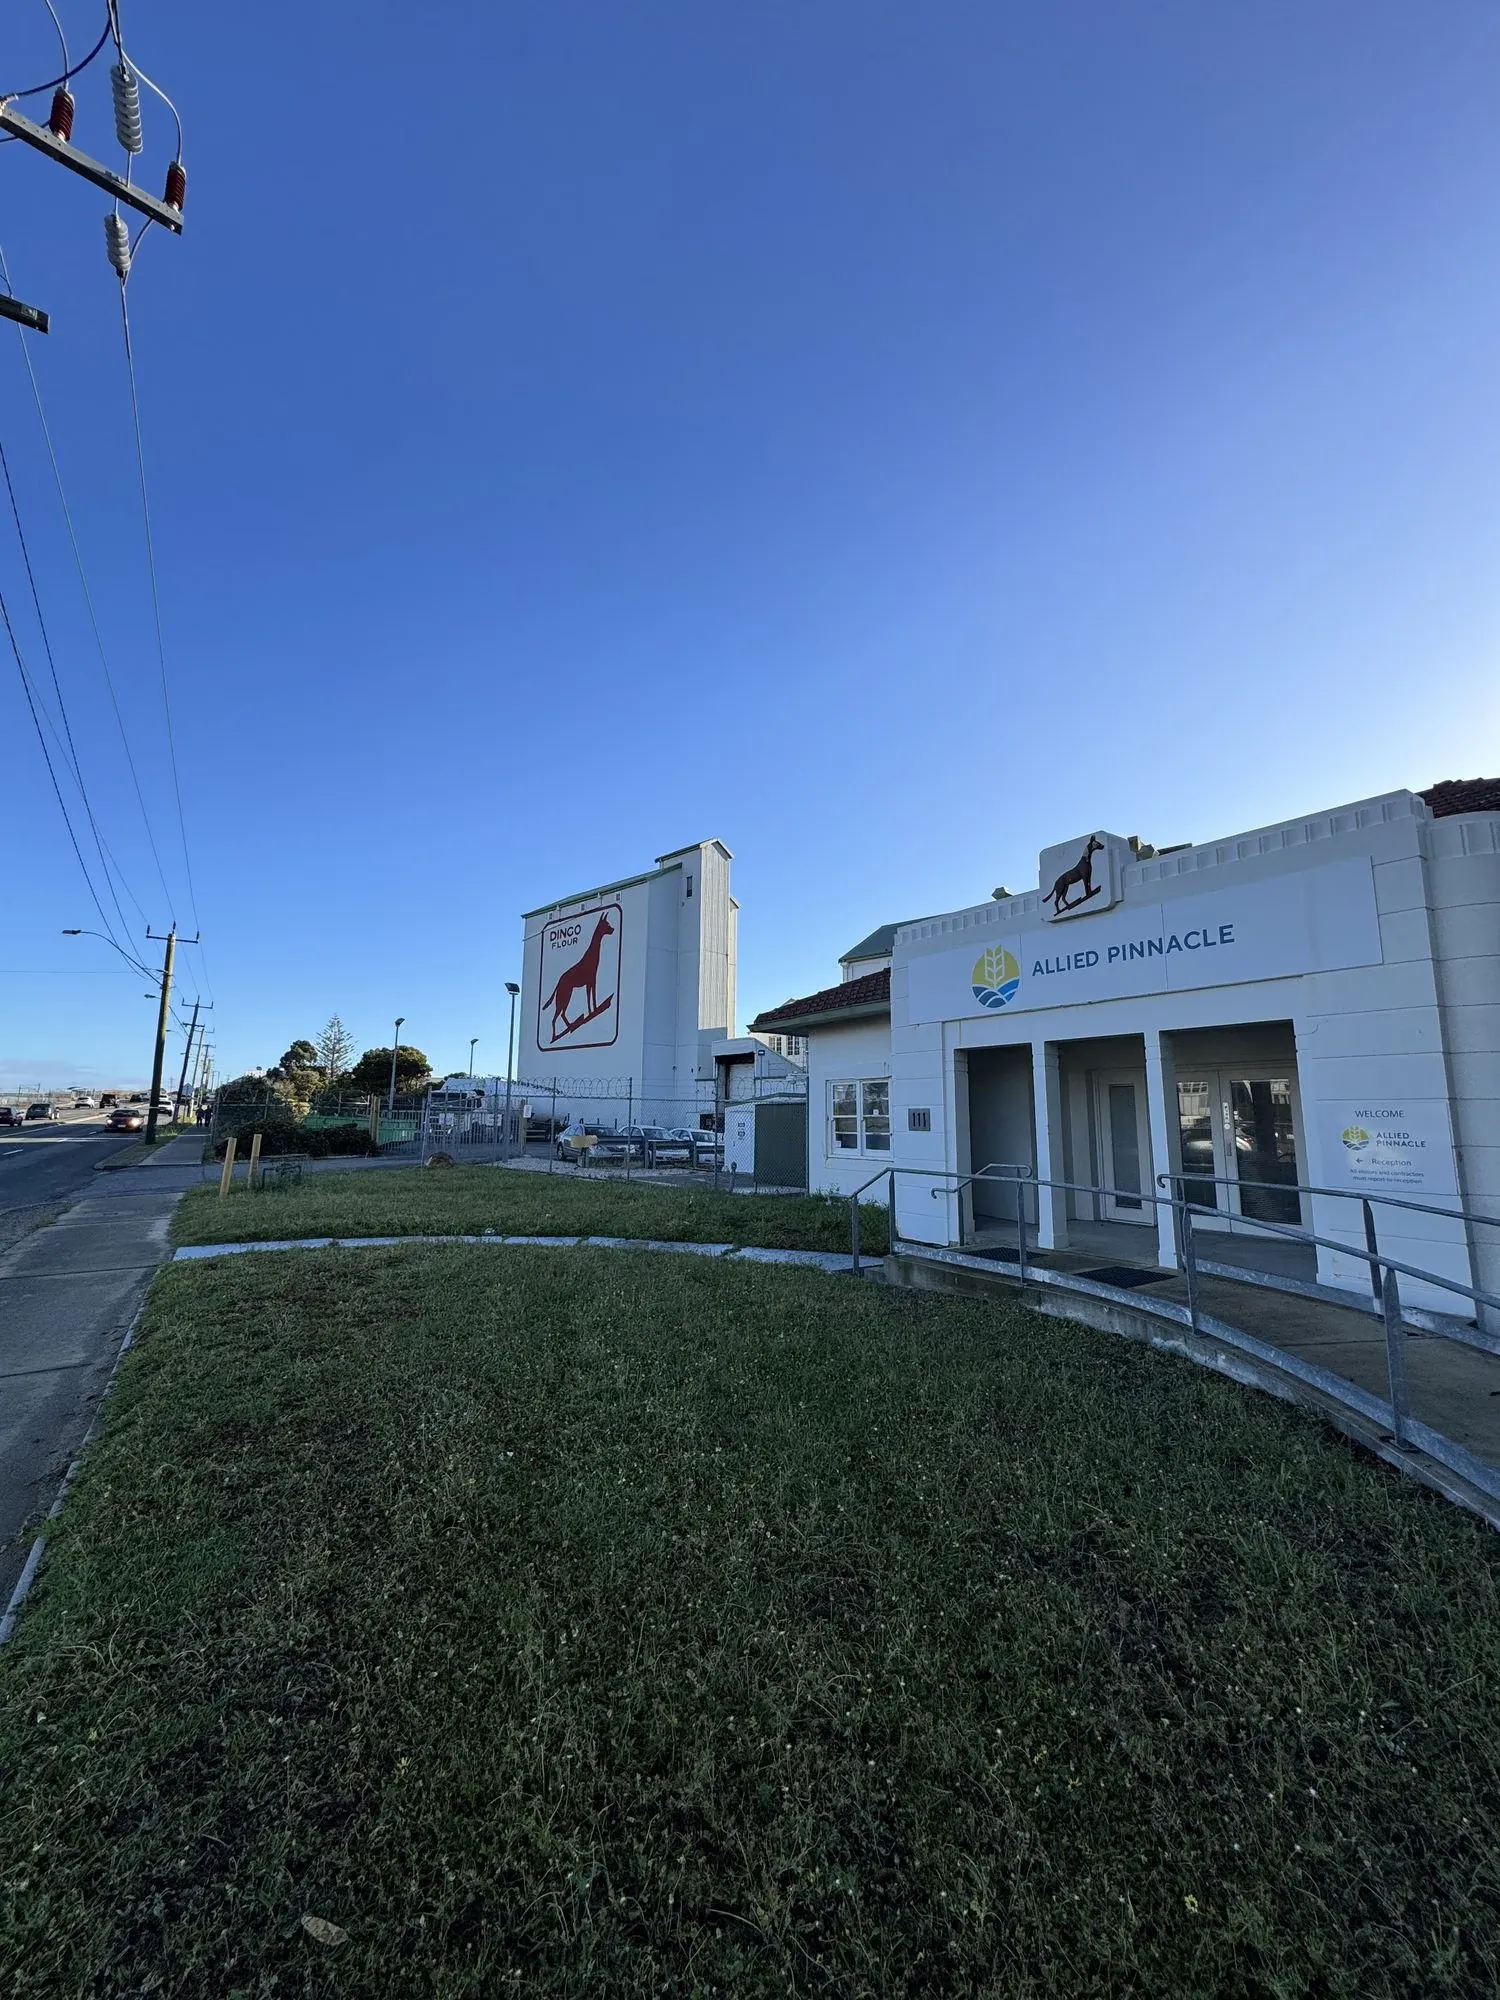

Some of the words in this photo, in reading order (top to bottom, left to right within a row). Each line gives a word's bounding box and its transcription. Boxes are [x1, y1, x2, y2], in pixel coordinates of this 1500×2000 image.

[550, 924, 581, 941] DINGO
[551, 937, 578, 949] FLOUR
[1031, 950, 1099, 976] ALLIED
[1107, 924, 1235, 963] PINNACLE
[912, 1112, 926, 1127] 111
[1354, 1110, 1405, 1118] WELCOME
[1376, 1140, 1427, 1148] PINNACLE
[1371, 1158, 1412, 1166] Reception
